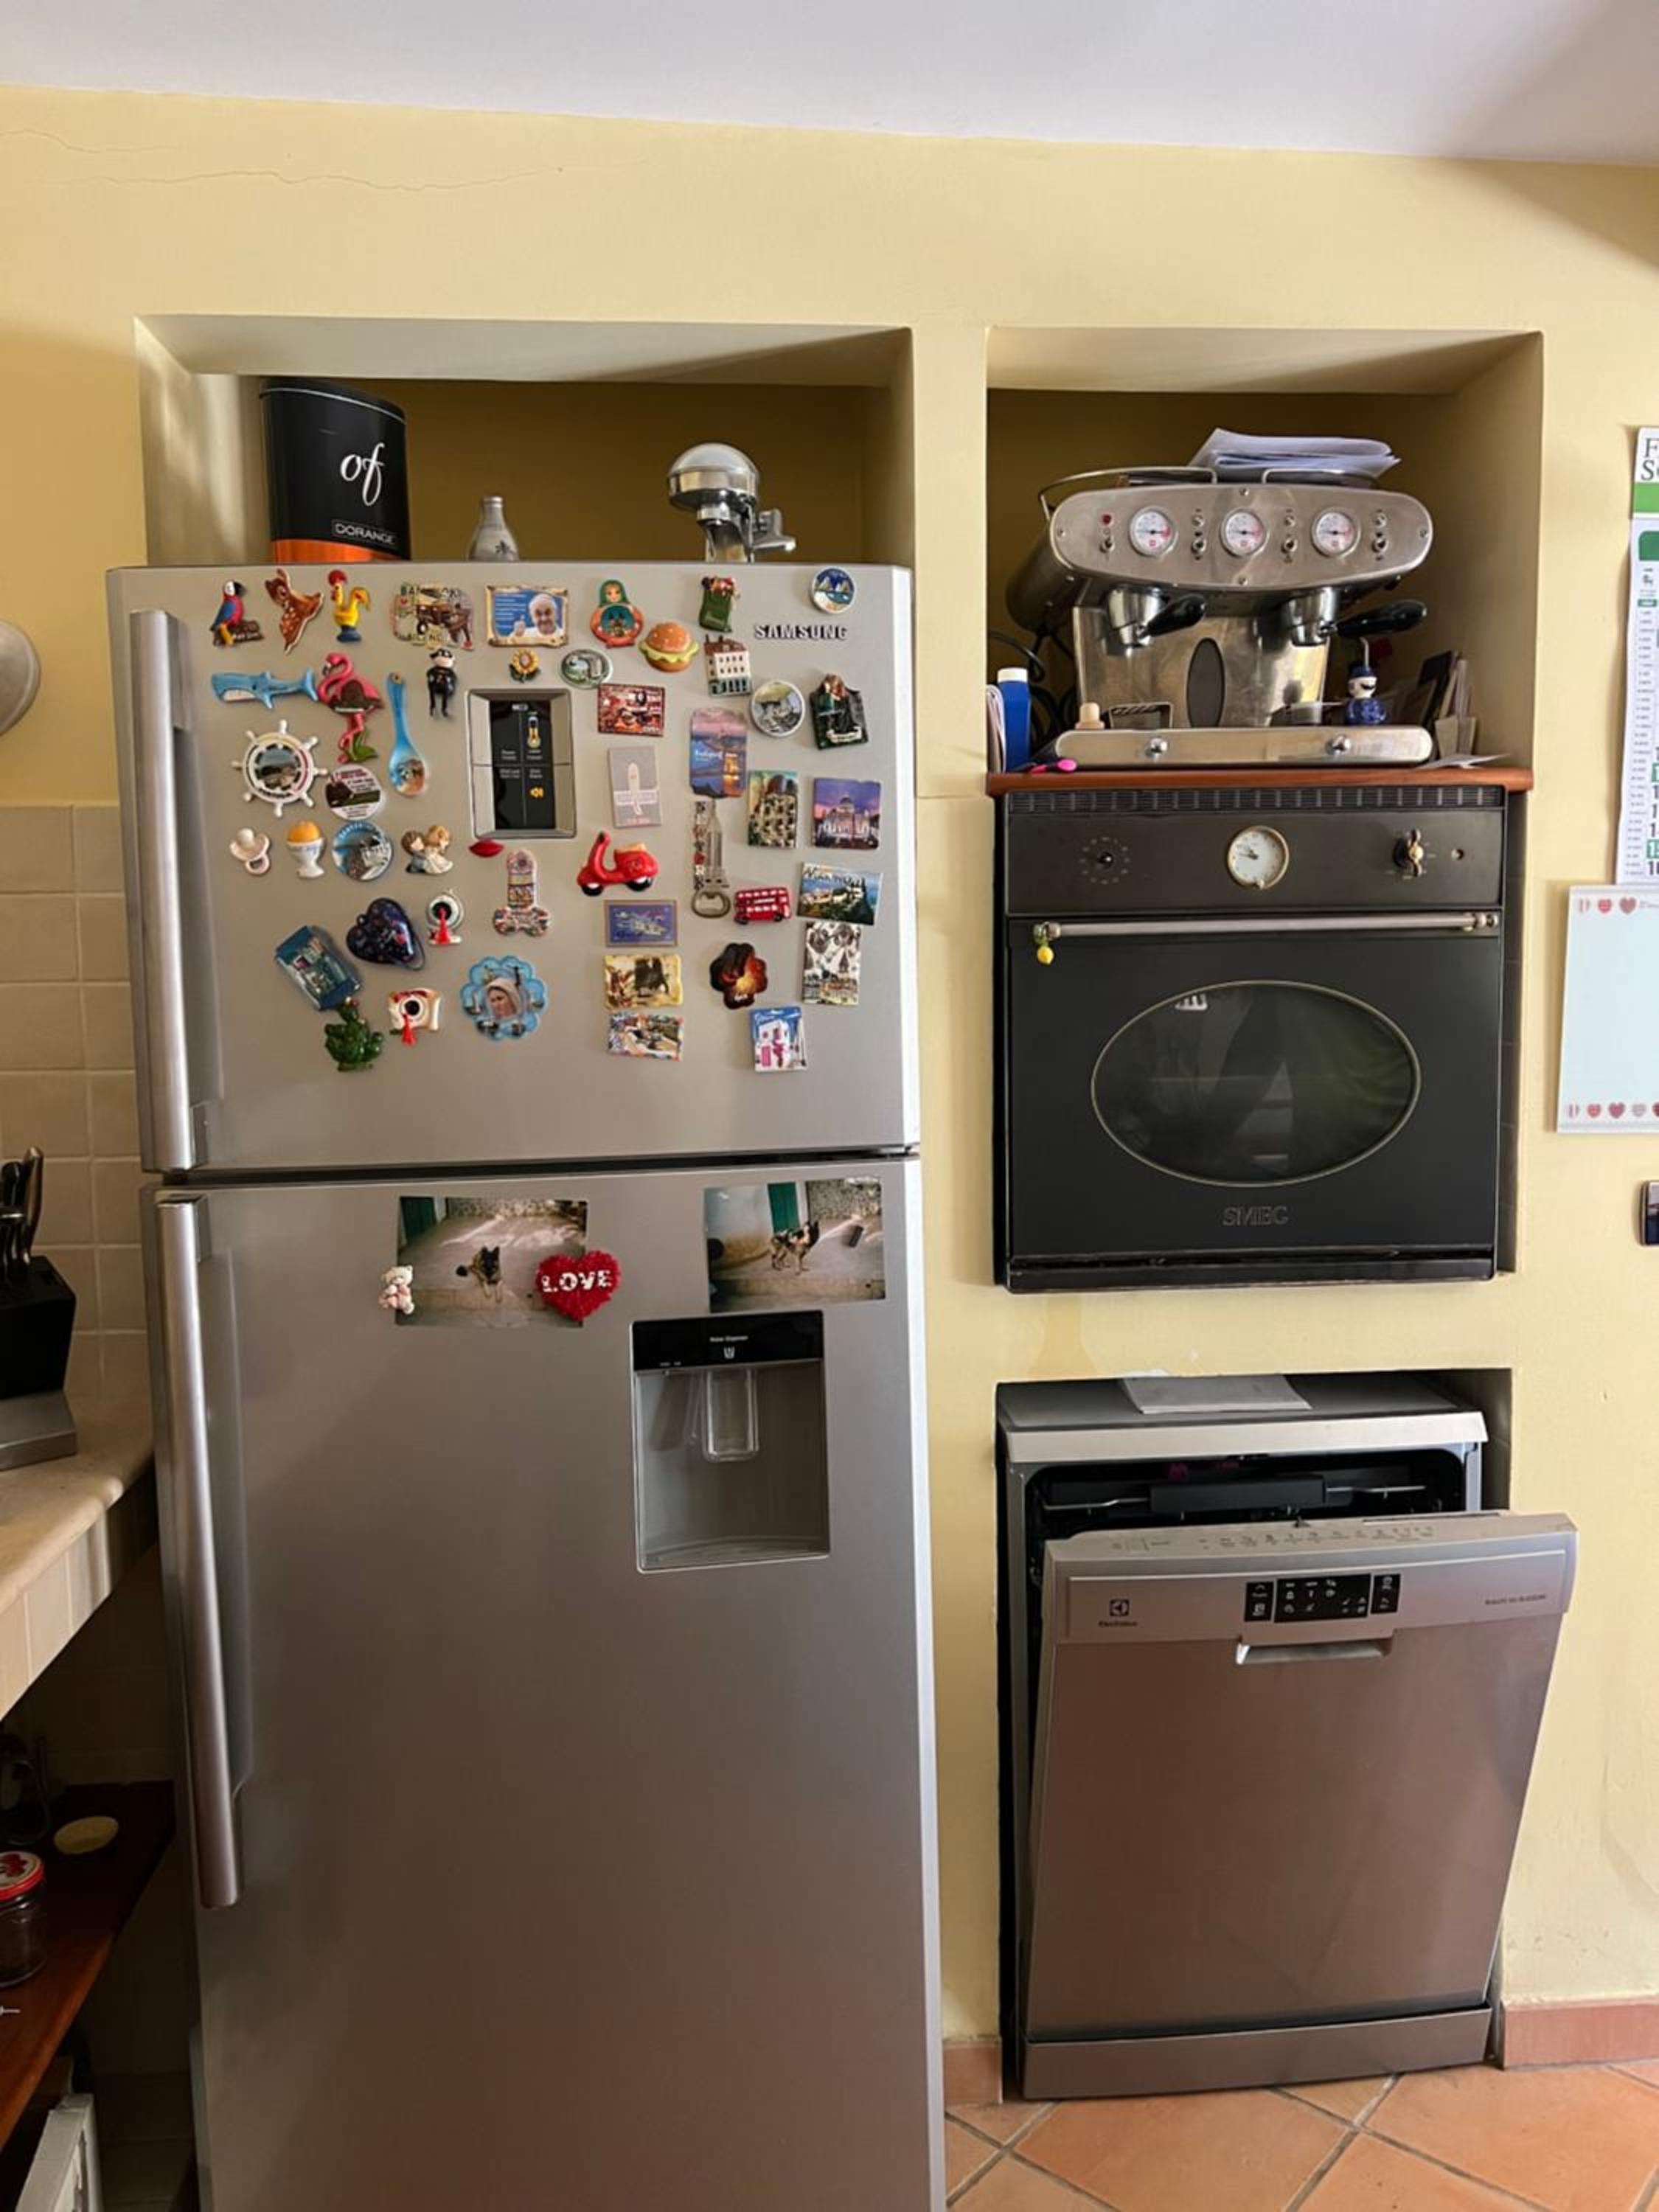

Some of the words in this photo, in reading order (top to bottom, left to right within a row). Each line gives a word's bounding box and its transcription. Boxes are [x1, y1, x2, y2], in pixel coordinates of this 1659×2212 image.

[340, 442, 386, 507] of
[754, 625, 849, 641] SAMSUNG
[1222, 1205, 1290, 1226] SMEG
[541, 1269, 612, 1293] LOVE
